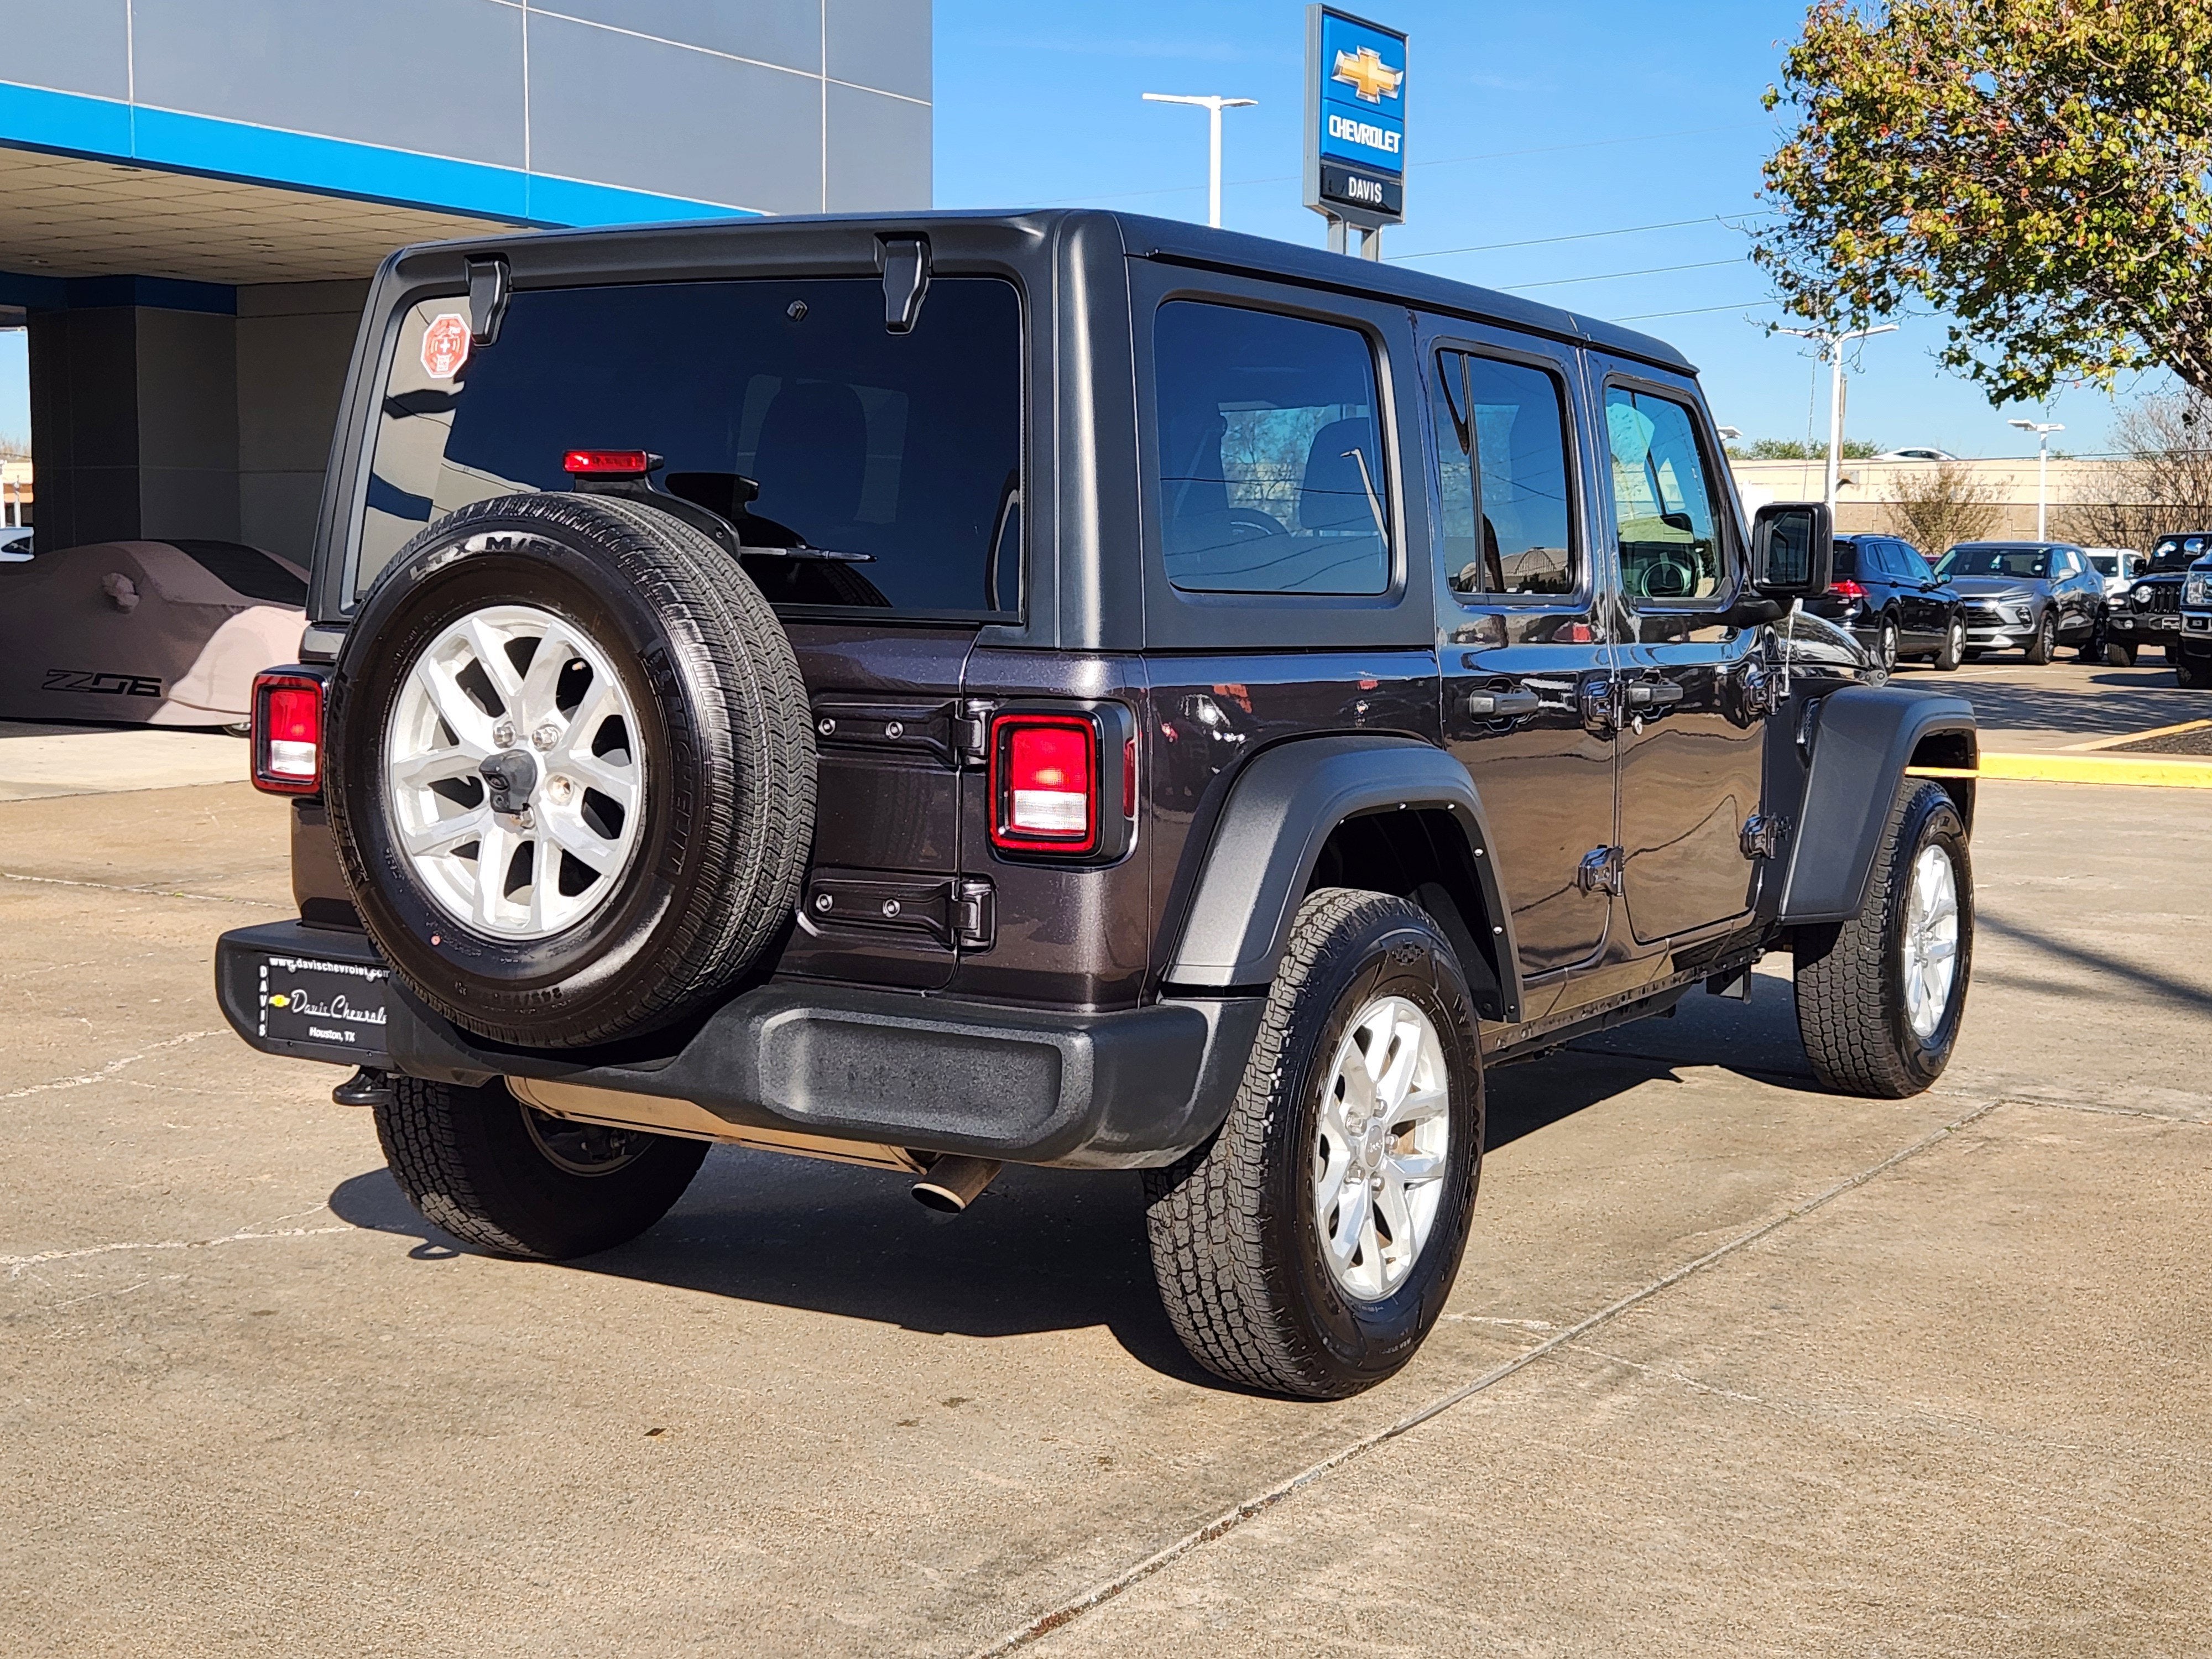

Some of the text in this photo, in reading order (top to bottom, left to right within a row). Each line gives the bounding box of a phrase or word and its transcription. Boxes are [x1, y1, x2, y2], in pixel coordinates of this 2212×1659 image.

[1329, 114, 1401, 153] CHEVROLET
[1348, 176, 1383, 204] DAVIS
[41, 669, 162, 698] Z06
[259, 966, 268, 1037] DAVIS
[290, 989, 331, 1016] Davis
[309, 1026, 356, 1042] Houston, TX
